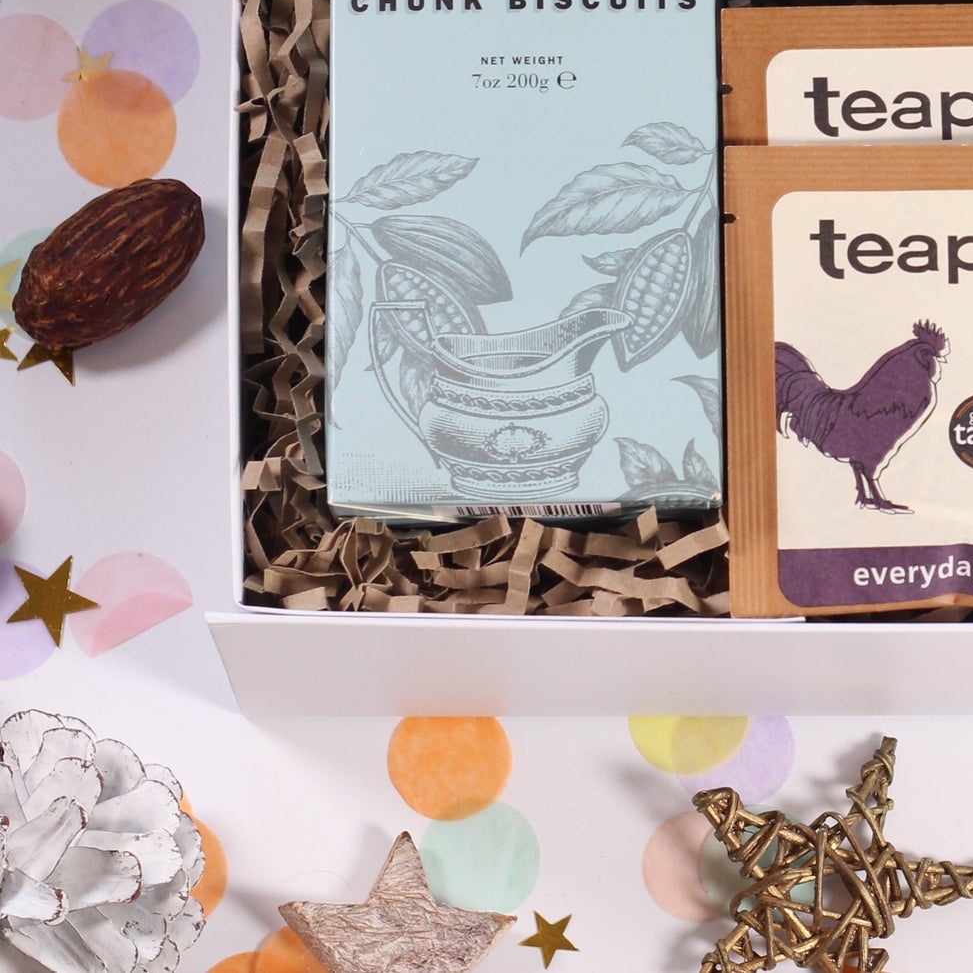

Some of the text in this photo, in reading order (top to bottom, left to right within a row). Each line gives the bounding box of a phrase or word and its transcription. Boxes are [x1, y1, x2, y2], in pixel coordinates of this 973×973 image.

[481, 55, 564, 65] NET WEIGHT
[471, 73, 501, 89] 7oz
[506, 73, 549, 92] 200g
